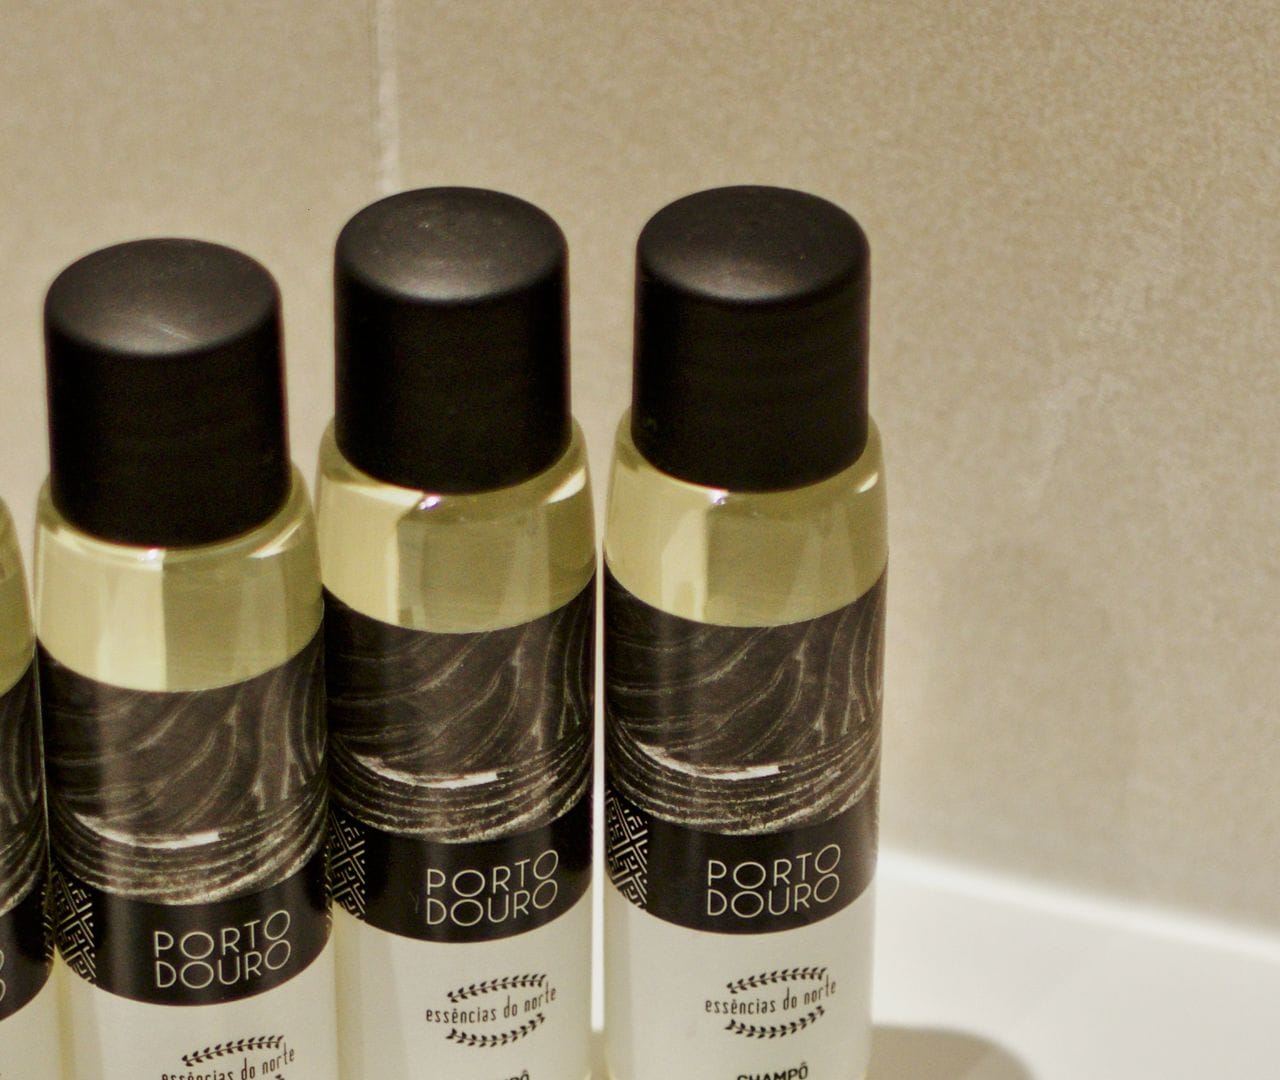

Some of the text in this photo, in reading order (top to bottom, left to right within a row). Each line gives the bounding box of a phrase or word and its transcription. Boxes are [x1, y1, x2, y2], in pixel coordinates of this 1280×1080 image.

[426, 850, 559, 897] PORTO
[708, 844, 840, 889] PORTO
[426, 879, 558, 926] DOURO
[707, 873, 840, 918] DOURO
[154, 910, 290, 960] PORTO
[156, 940, 291, 989] DOURO
[426, 982, 556, 1023] essências do norte
[705, 976, 836, 1014] essências do norte
[241, 1058, 256, 1080] do
[262, 1042, 295, 1074] norte
